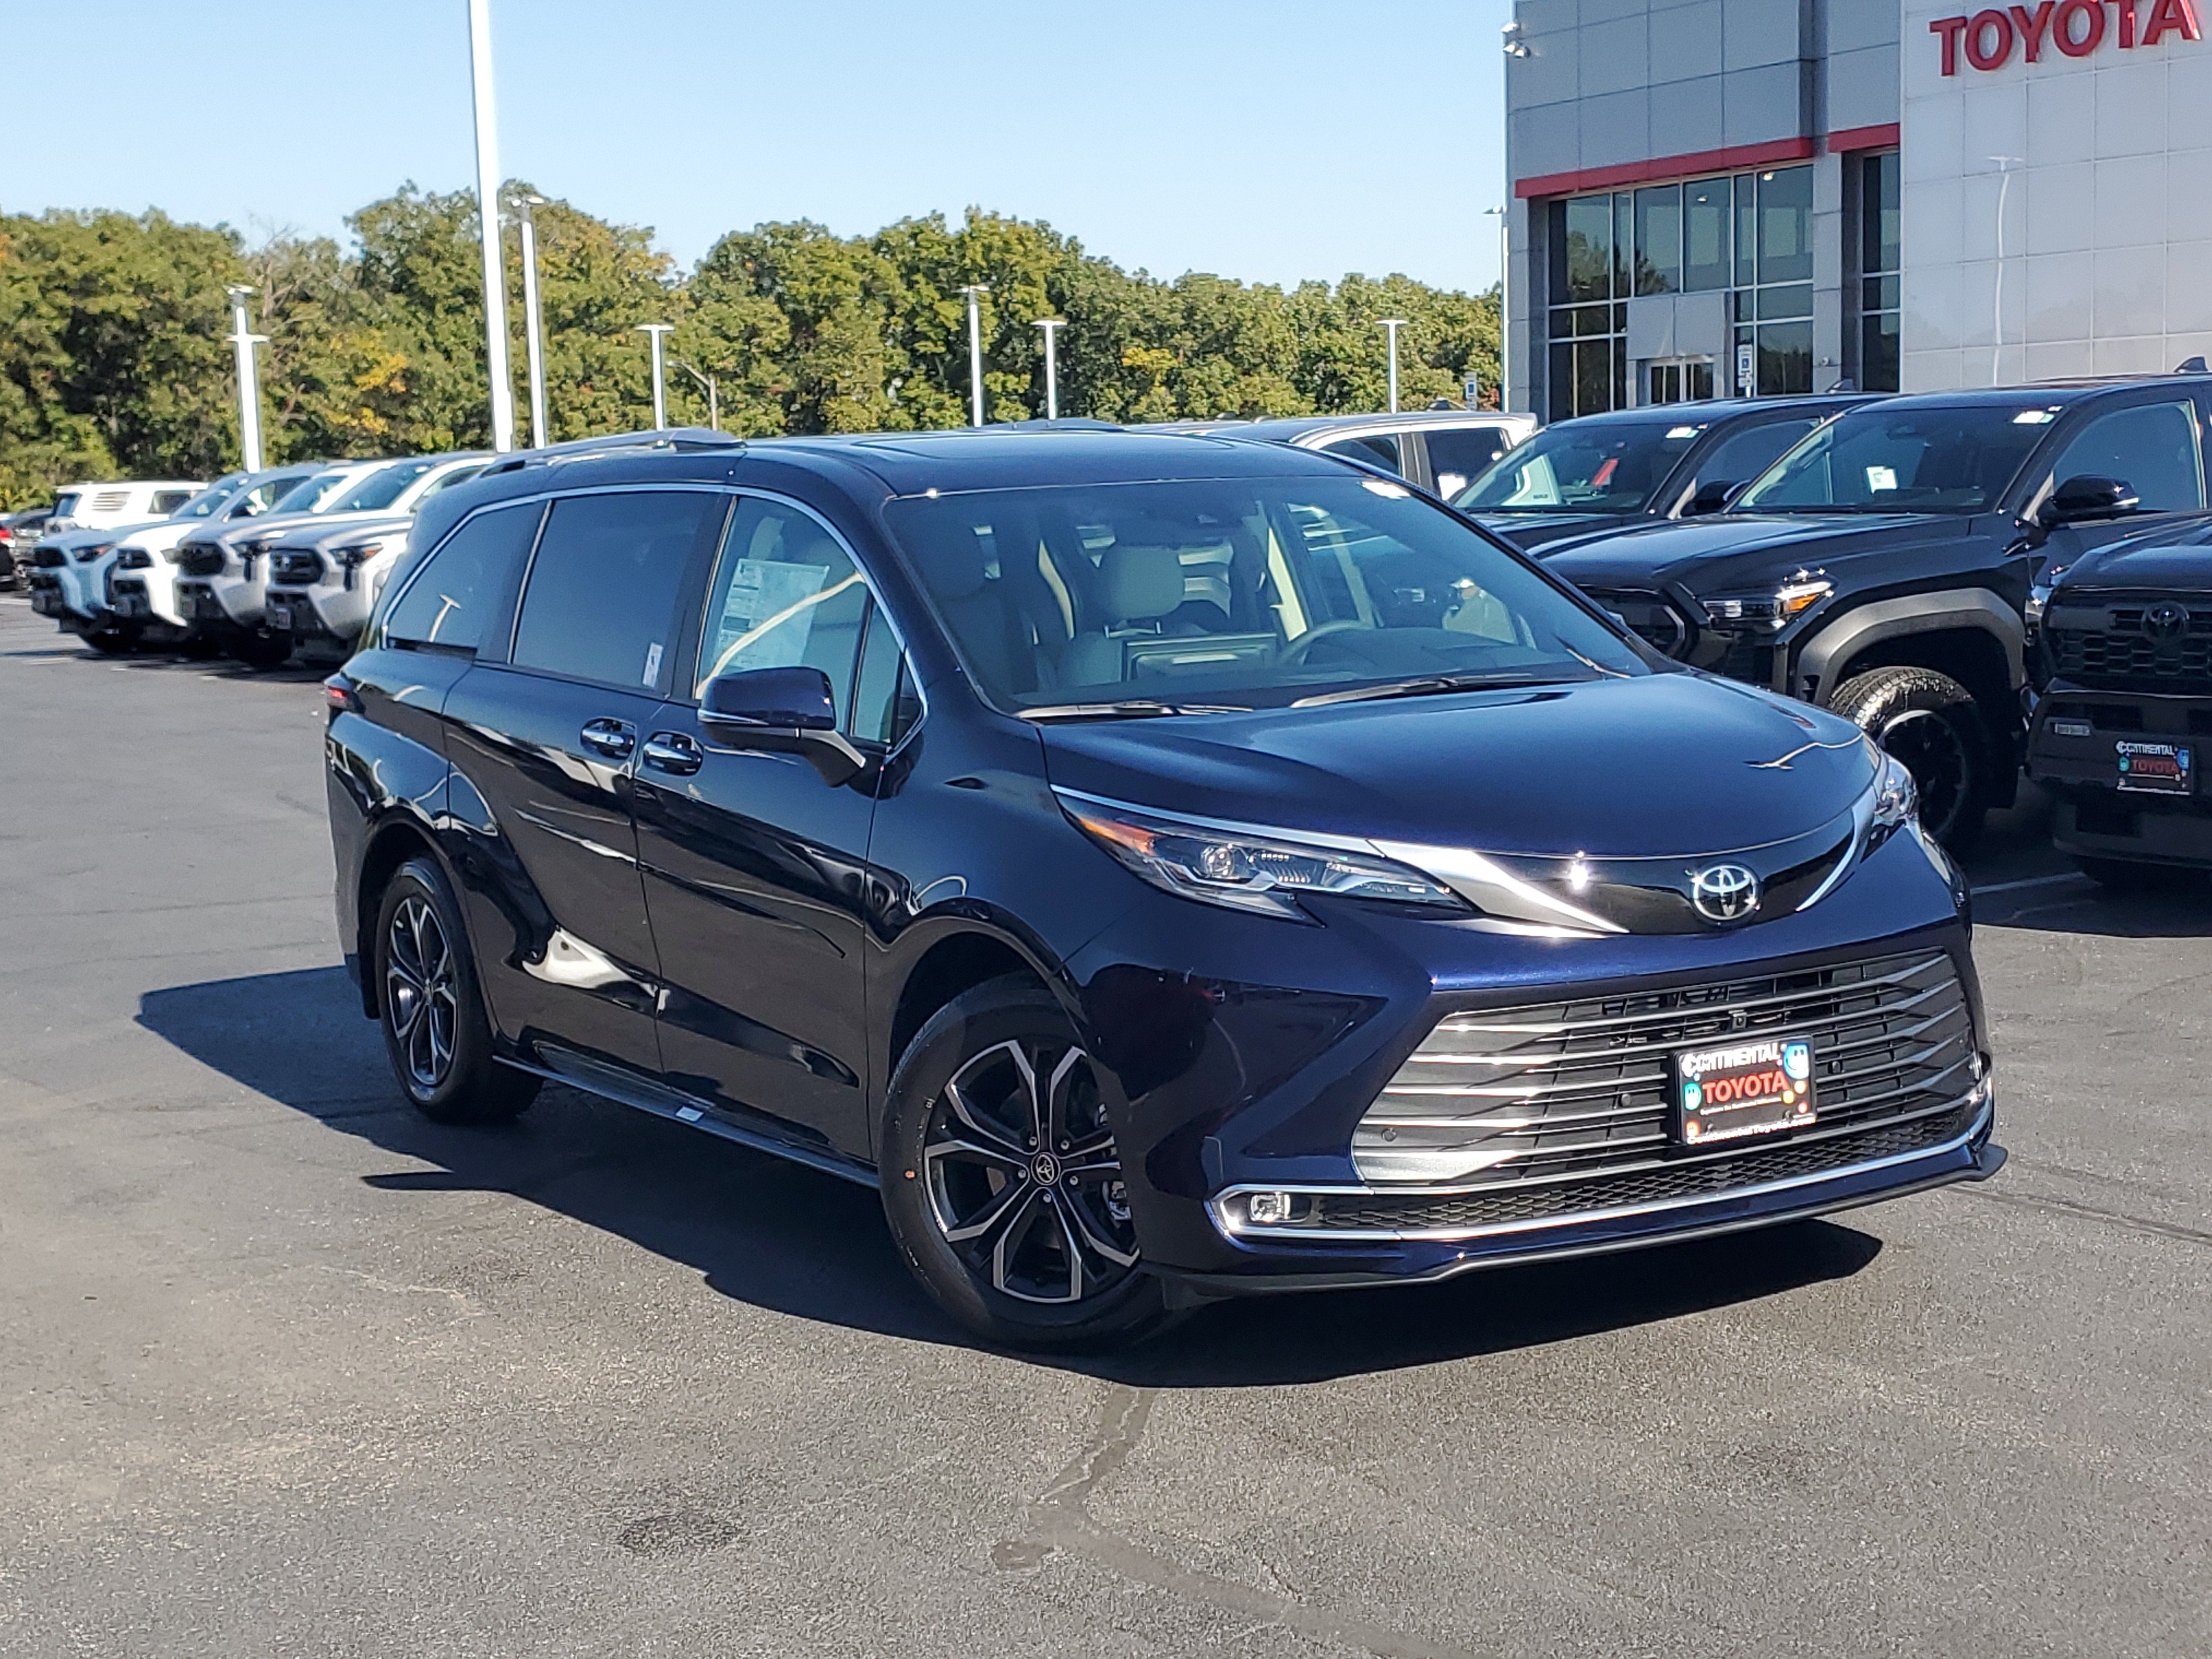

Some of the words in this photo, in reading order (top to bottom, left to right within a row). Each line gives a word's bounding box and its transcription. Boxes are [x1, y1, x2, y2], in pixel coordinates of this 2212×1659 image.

[1929, 0, 2202, 77] TOYOTA
[2132, 759, 2180, 774] TOYOTA
[1702, 1071, 1790, 1104] TOYOTA
